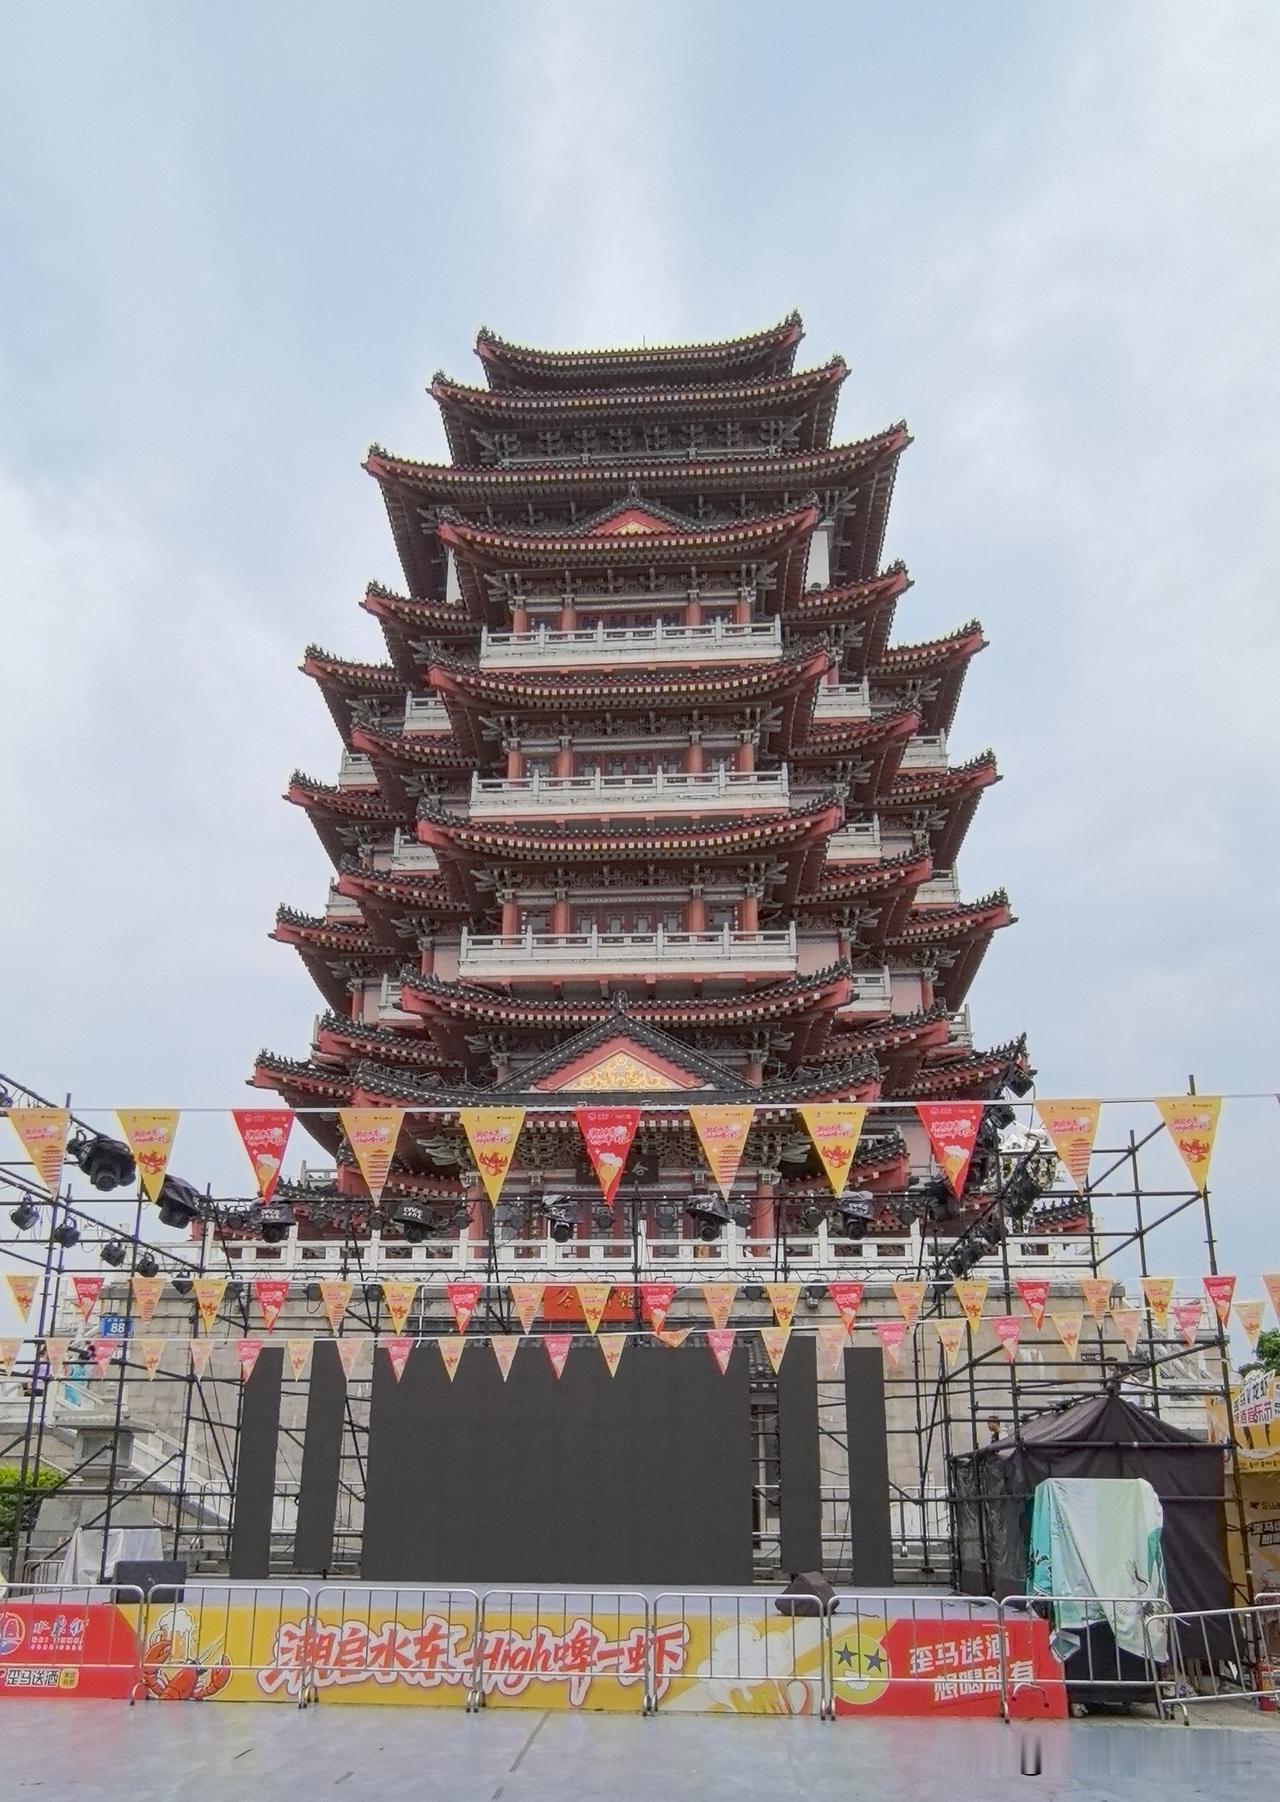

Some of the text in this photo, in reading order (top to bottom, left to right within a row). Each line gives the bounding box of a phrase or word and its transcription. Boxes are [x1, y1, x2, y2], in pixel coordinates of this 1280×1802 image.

[110, 1322, 125, 1333] 88
[909, 1632, 1010, 1674] 歪马送酒
[6, 1669, 59, 1686] 歪马送酒
[933, 1660, 1035, 1701] 想喝就有
